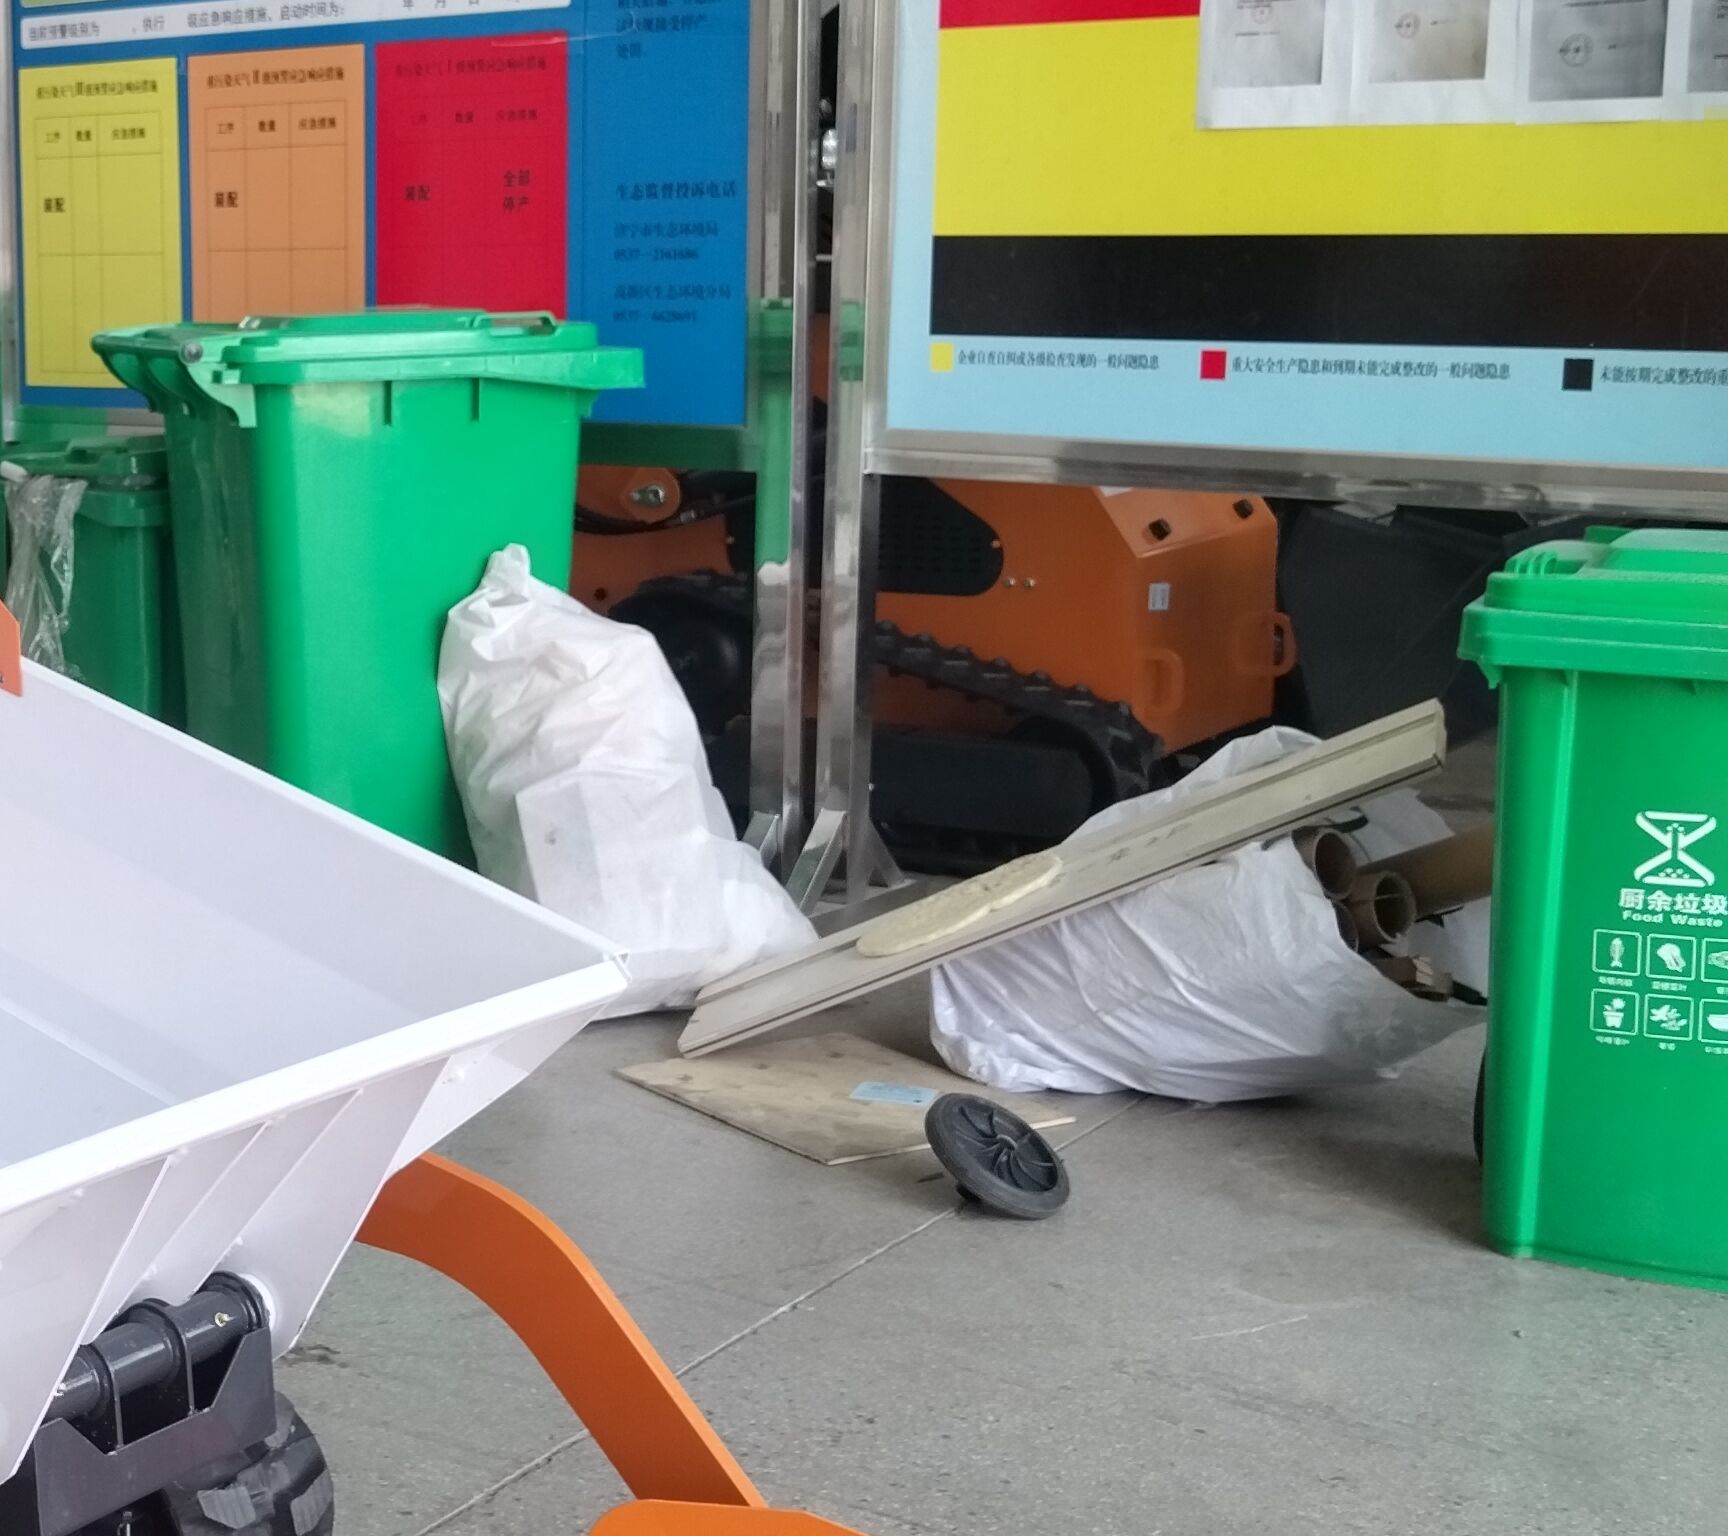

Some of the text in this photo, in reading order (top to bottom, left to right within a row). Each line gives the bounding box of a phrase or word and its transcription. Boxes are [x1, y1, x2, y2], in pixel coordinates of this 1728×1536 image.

[503, 168, 531, 187] 全部
[214, 191, 239, 208] 装配
[404, 184, 431, 201] 装配
[43, 197, 66, 213] 装配
[503, 195, 530, 214] 停产
[1618, 888, 1728, 915] 厨余垃圾
[1622, 910, 1724, 928] Food Waste
